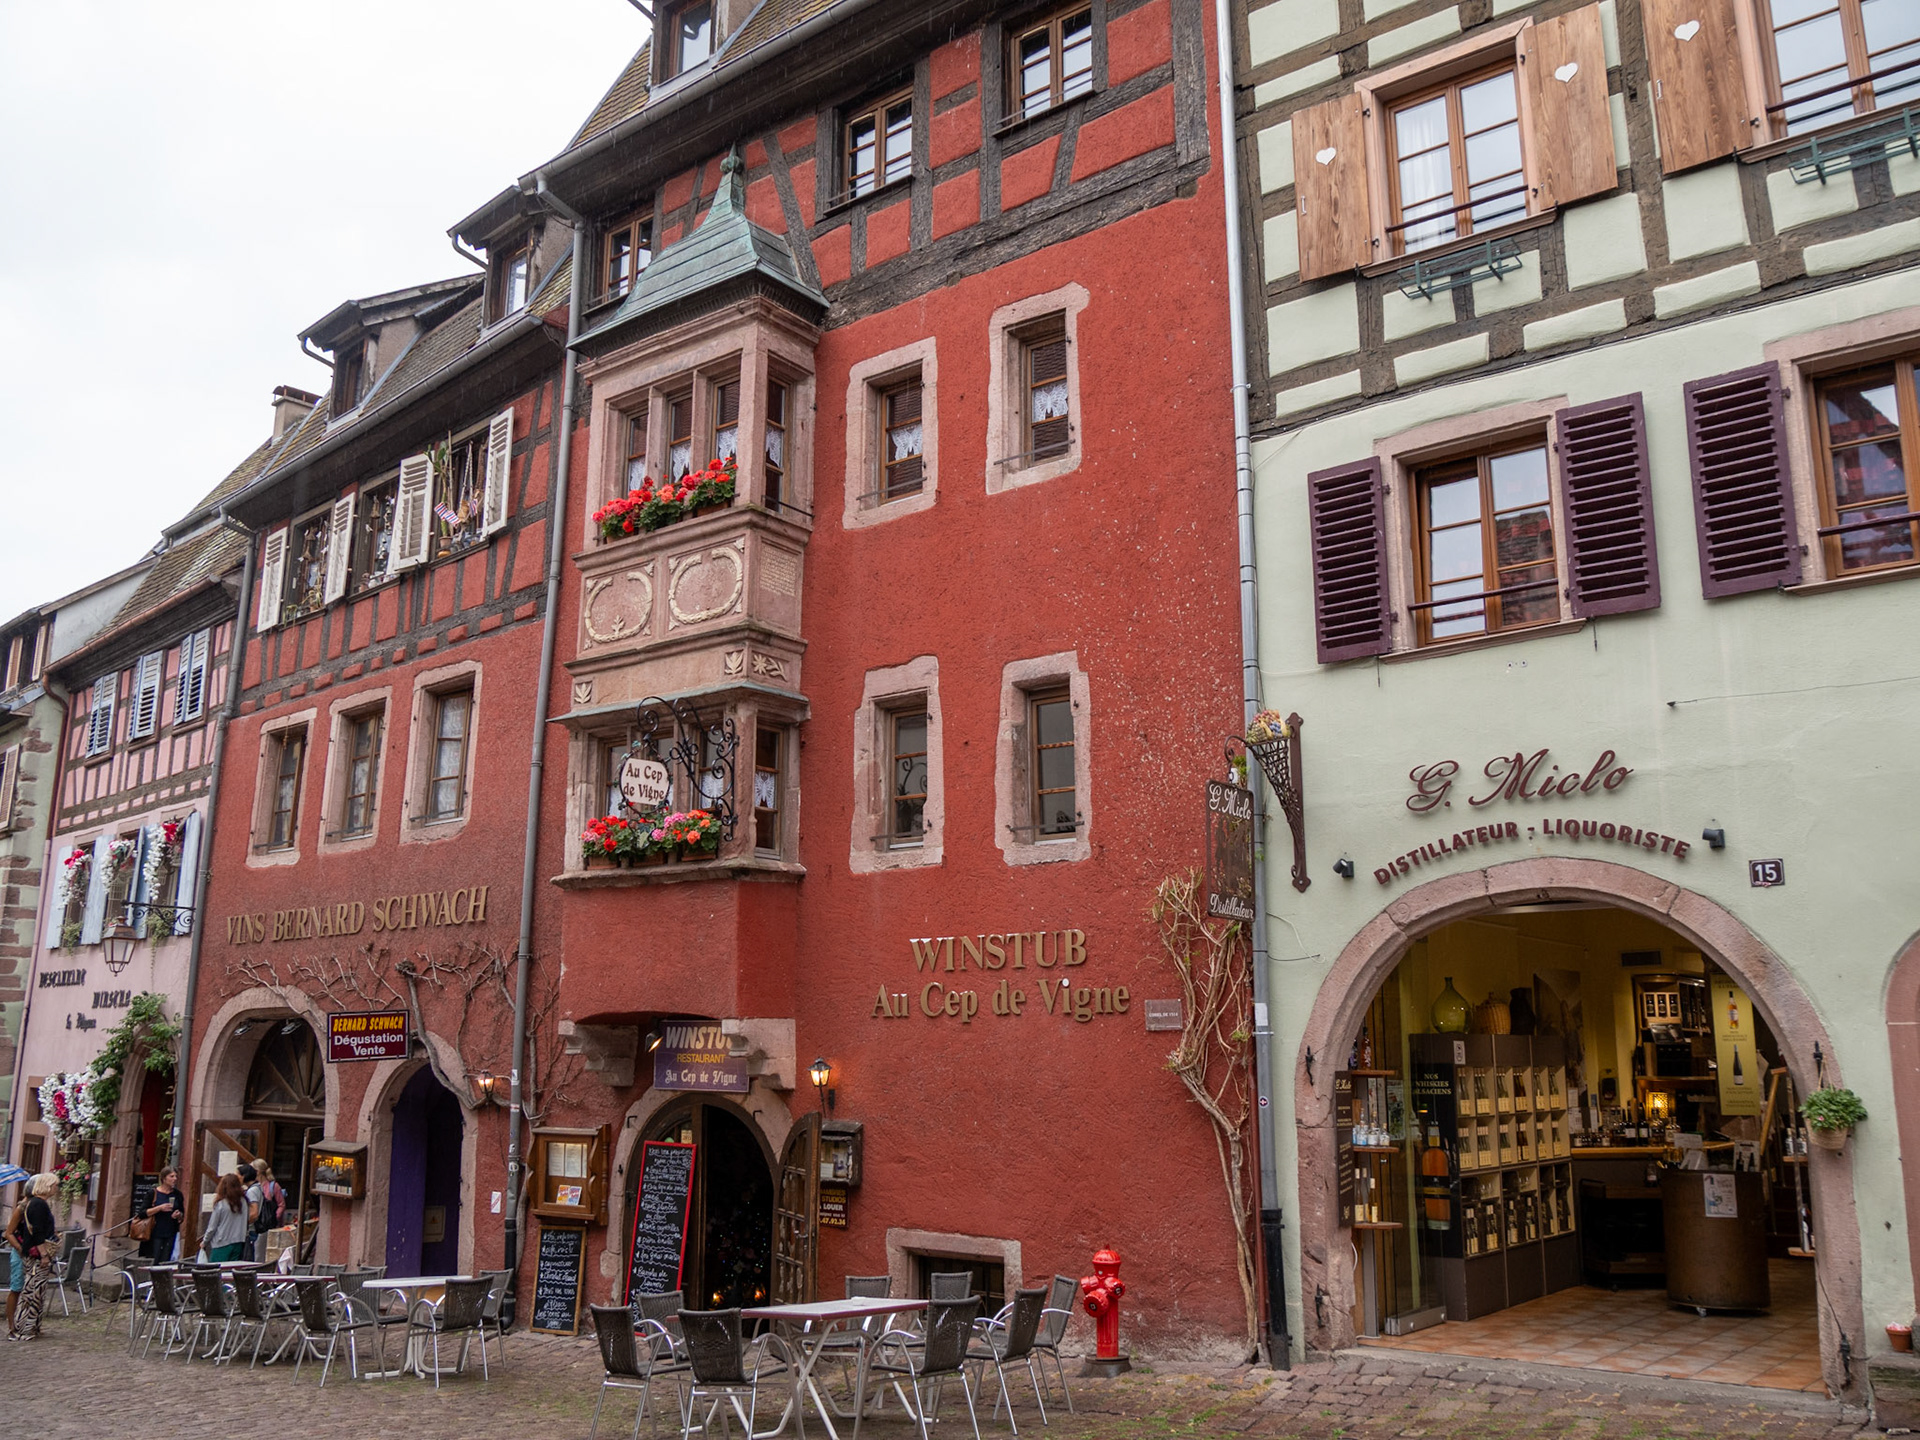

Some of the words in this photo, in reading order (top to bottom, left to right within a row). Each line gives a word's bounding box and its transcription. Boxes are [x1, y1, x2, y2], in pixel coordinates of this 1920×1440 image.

[626, 763, 640, 778] Au
[644, 766, 662, 783] Cep
[1406, 760, 1459, 812] G.
[1468, 748, 1634, 806] Miclo
[623, 783, 635, 796] de
[638, 784, 664, 801] Vigne
[1222, 788, 1251, 820] Miclo
[1373, 821, 1518, 884] DISTILLATEUR
[1543, 818, 1691, 859] LIQUORISTE
[1754, 862, 1778, 883] 15
[227, 913, 266, 944] VINS
[272, 901, 365, 942] BERNARD
[372, 886, 489, 932] SCHWACH
[1210, 893, 1254, 919] Distillateur
[909, 929, 1088, 972] WINSTUB
[871, 984, 909, 1018] Au
[920, 982, 978, 1023] Cep
[992, 980, 1026, 1015] de
[1037, 978, 1130, 1022] Vigne
[333, 1017, 367, 1032] BERNARD
[369, 1016, 404, 1031] SCHWACH
[334, 1033, 403, 1047] Dégustation
[665, 1026, 733, 1050] WINSTU
[353, 1045, 386, 1056] Vente
[677, 1053, 726, 1063] RESTAURANT
[665, 1069, 677, 1083] Au
[681, 1069, 697, 1085] Cep
[700, 1070, 709, 1083] de
[713, 1070, 737, 1086] Vigne
[823, 1203, 844, 1211] LOUER
